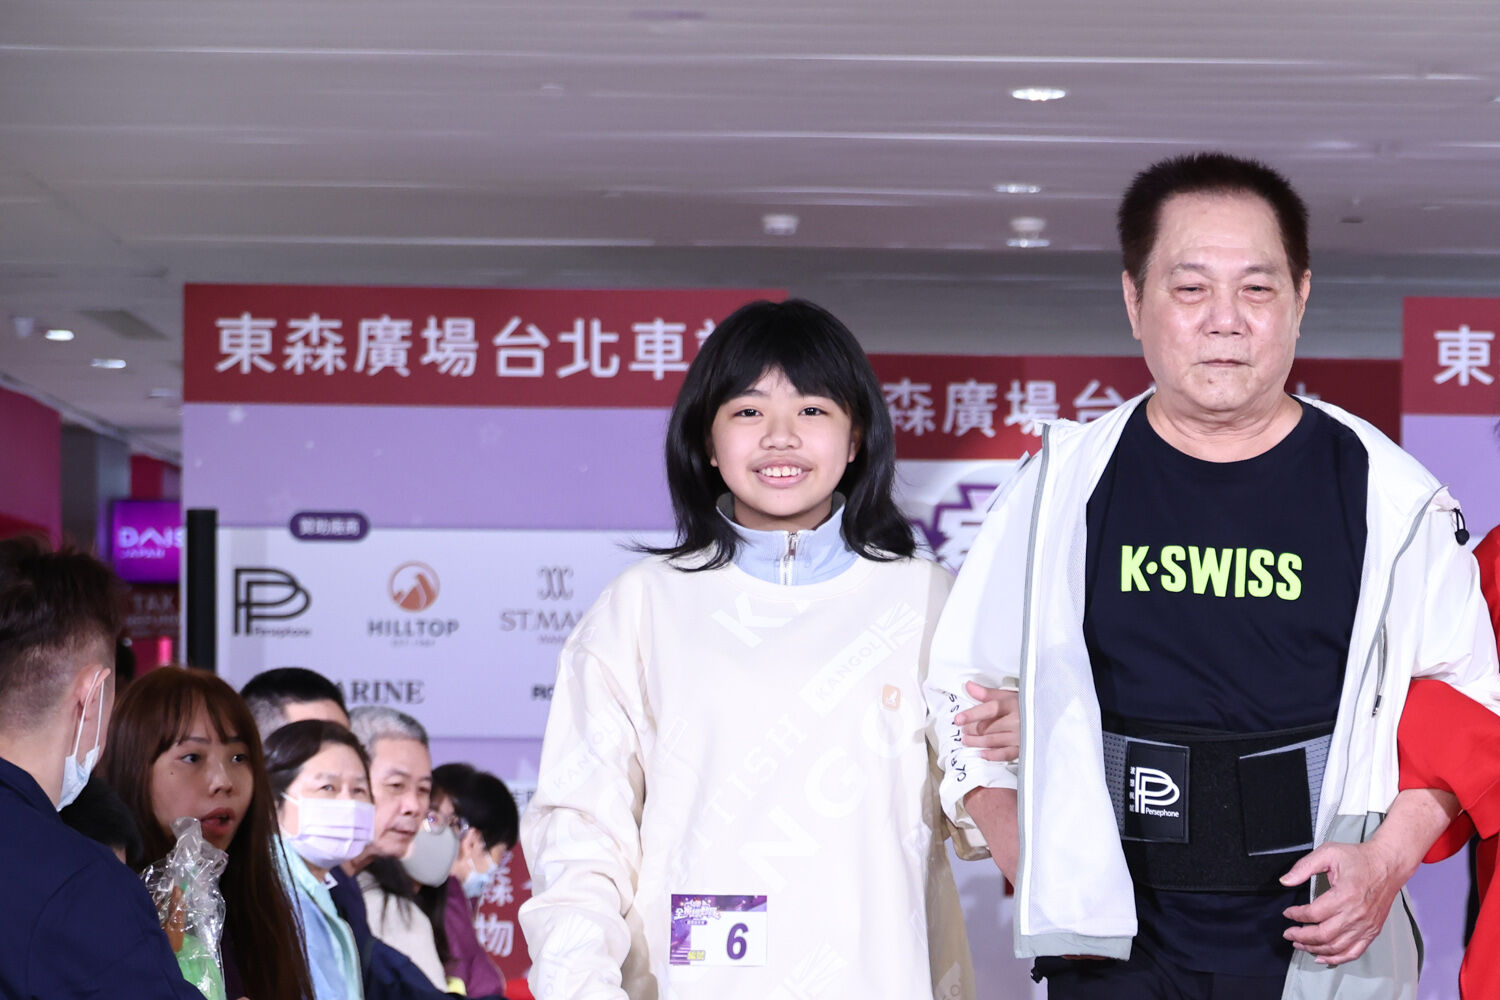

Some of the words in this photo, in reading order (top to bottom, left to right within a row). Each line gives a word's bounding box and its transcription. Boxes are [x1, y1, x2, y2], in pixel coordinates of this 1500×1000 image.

[214, 312, 712, 382] 東森廣場台北車
[366, 619, 460, 638] HILLTOP
[726, 922, 749, 961] 6
